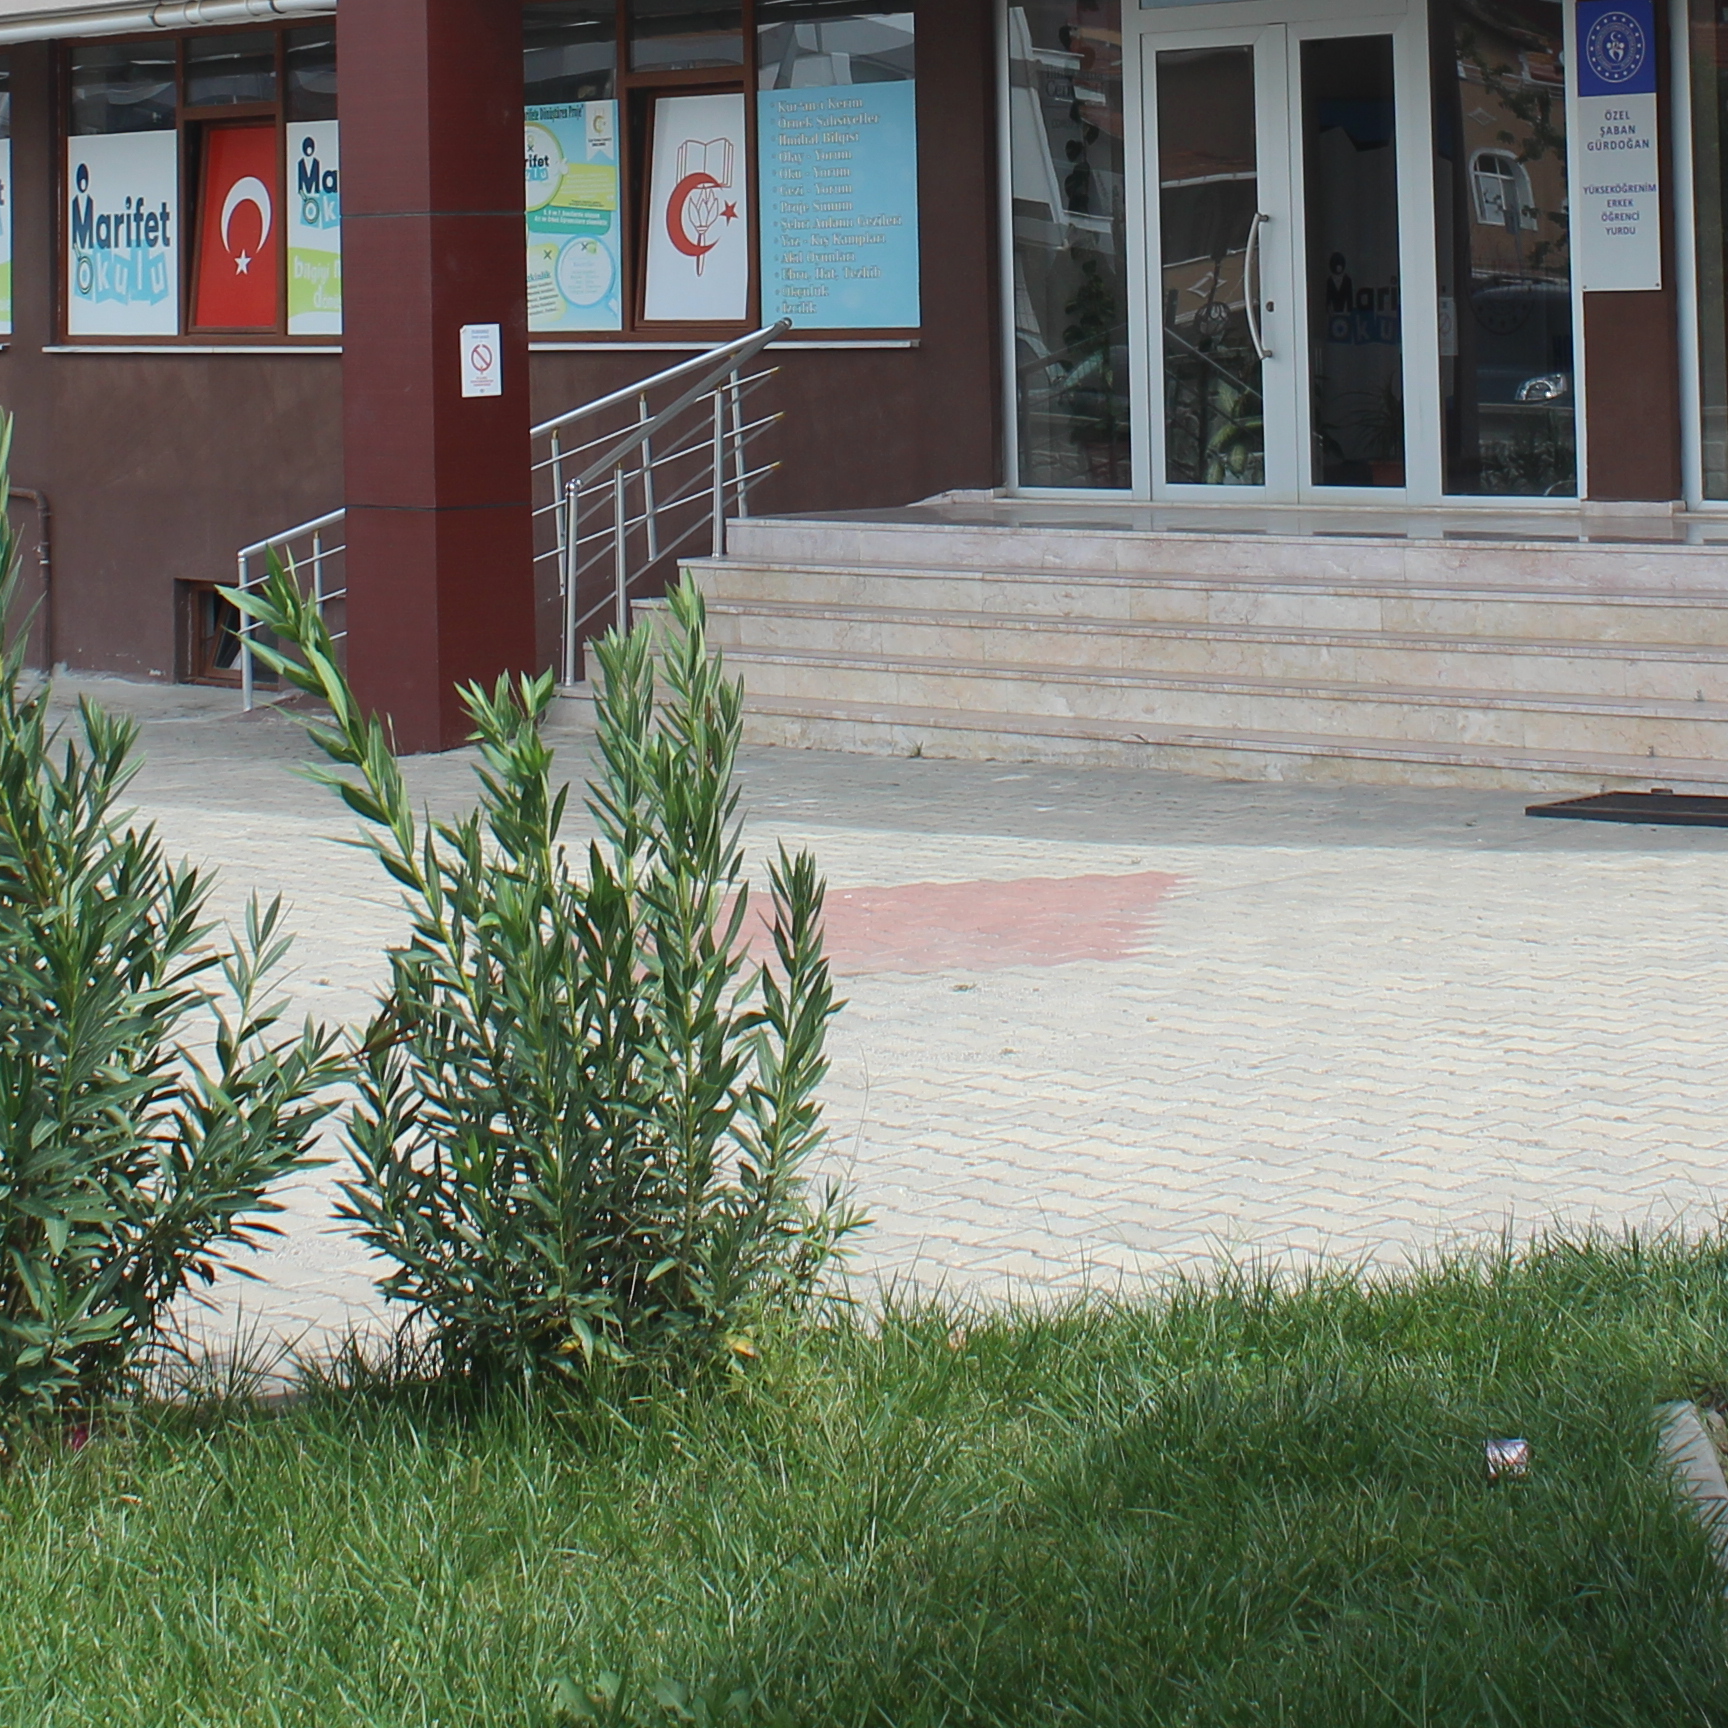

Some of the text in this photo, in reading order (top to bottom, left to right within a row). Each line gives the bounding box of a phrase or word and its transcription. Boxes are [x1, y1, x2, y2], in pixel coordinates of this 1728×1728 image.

[828, 97, 864, 110] Kerim
[1604, 108, 1631, 121] ÖZEL
[1600, 125, 1636, 139] ŞABAN
[1587, 136, 1650, 152] GÜRDOĞAN
[779, 151, 803, 164] Olay
[815, 149, 852, 161] Yorum
[298, 157, 338, 193] Ma
[779, 168, 802, 179] Oku
[814, 166, 850, 178] Yorum
[780, 184, 804, 196] Gezi
[816, 182, 852, 194] Yorum
[1583, 182, 1657, 196] YÜKSEKÖĞRENİM
[303, 196, 336, 222] ok
[1607, 198, 1634, 208] ERKEK
[72, 194, 170, 250] Marifet
[1601, 210, 1640, 223] ÖĞRENCİ
[1605, 226, 1636, 236] YURDU
[781, 235, 800, 246] Yaz
